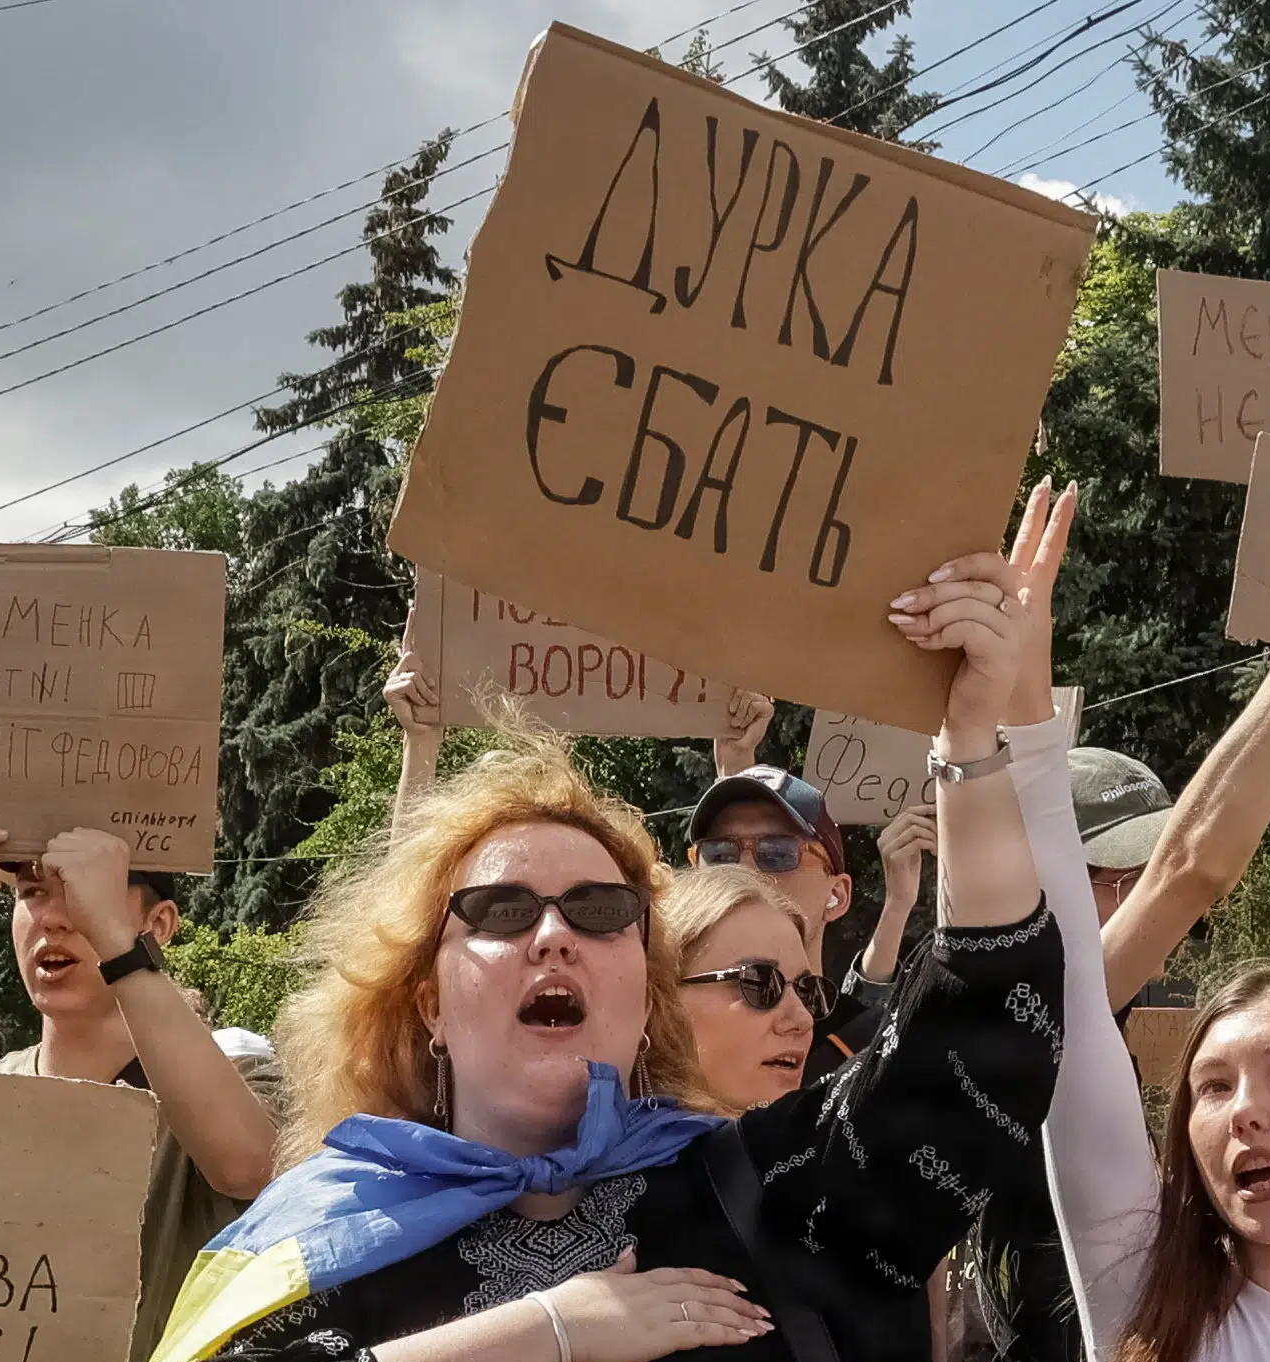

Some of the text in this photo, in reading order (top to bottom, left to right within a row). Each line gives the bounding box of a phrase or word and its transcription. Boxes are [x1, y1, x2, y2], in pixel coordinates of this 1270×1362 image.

[545, 97, 918, 385] ДУРКА
[526, 345, 858, 588] ЄБАТЬ
[51, 731, 202, 787] ФЕДОРОВА
[135, 830, 172, 851] УСС
